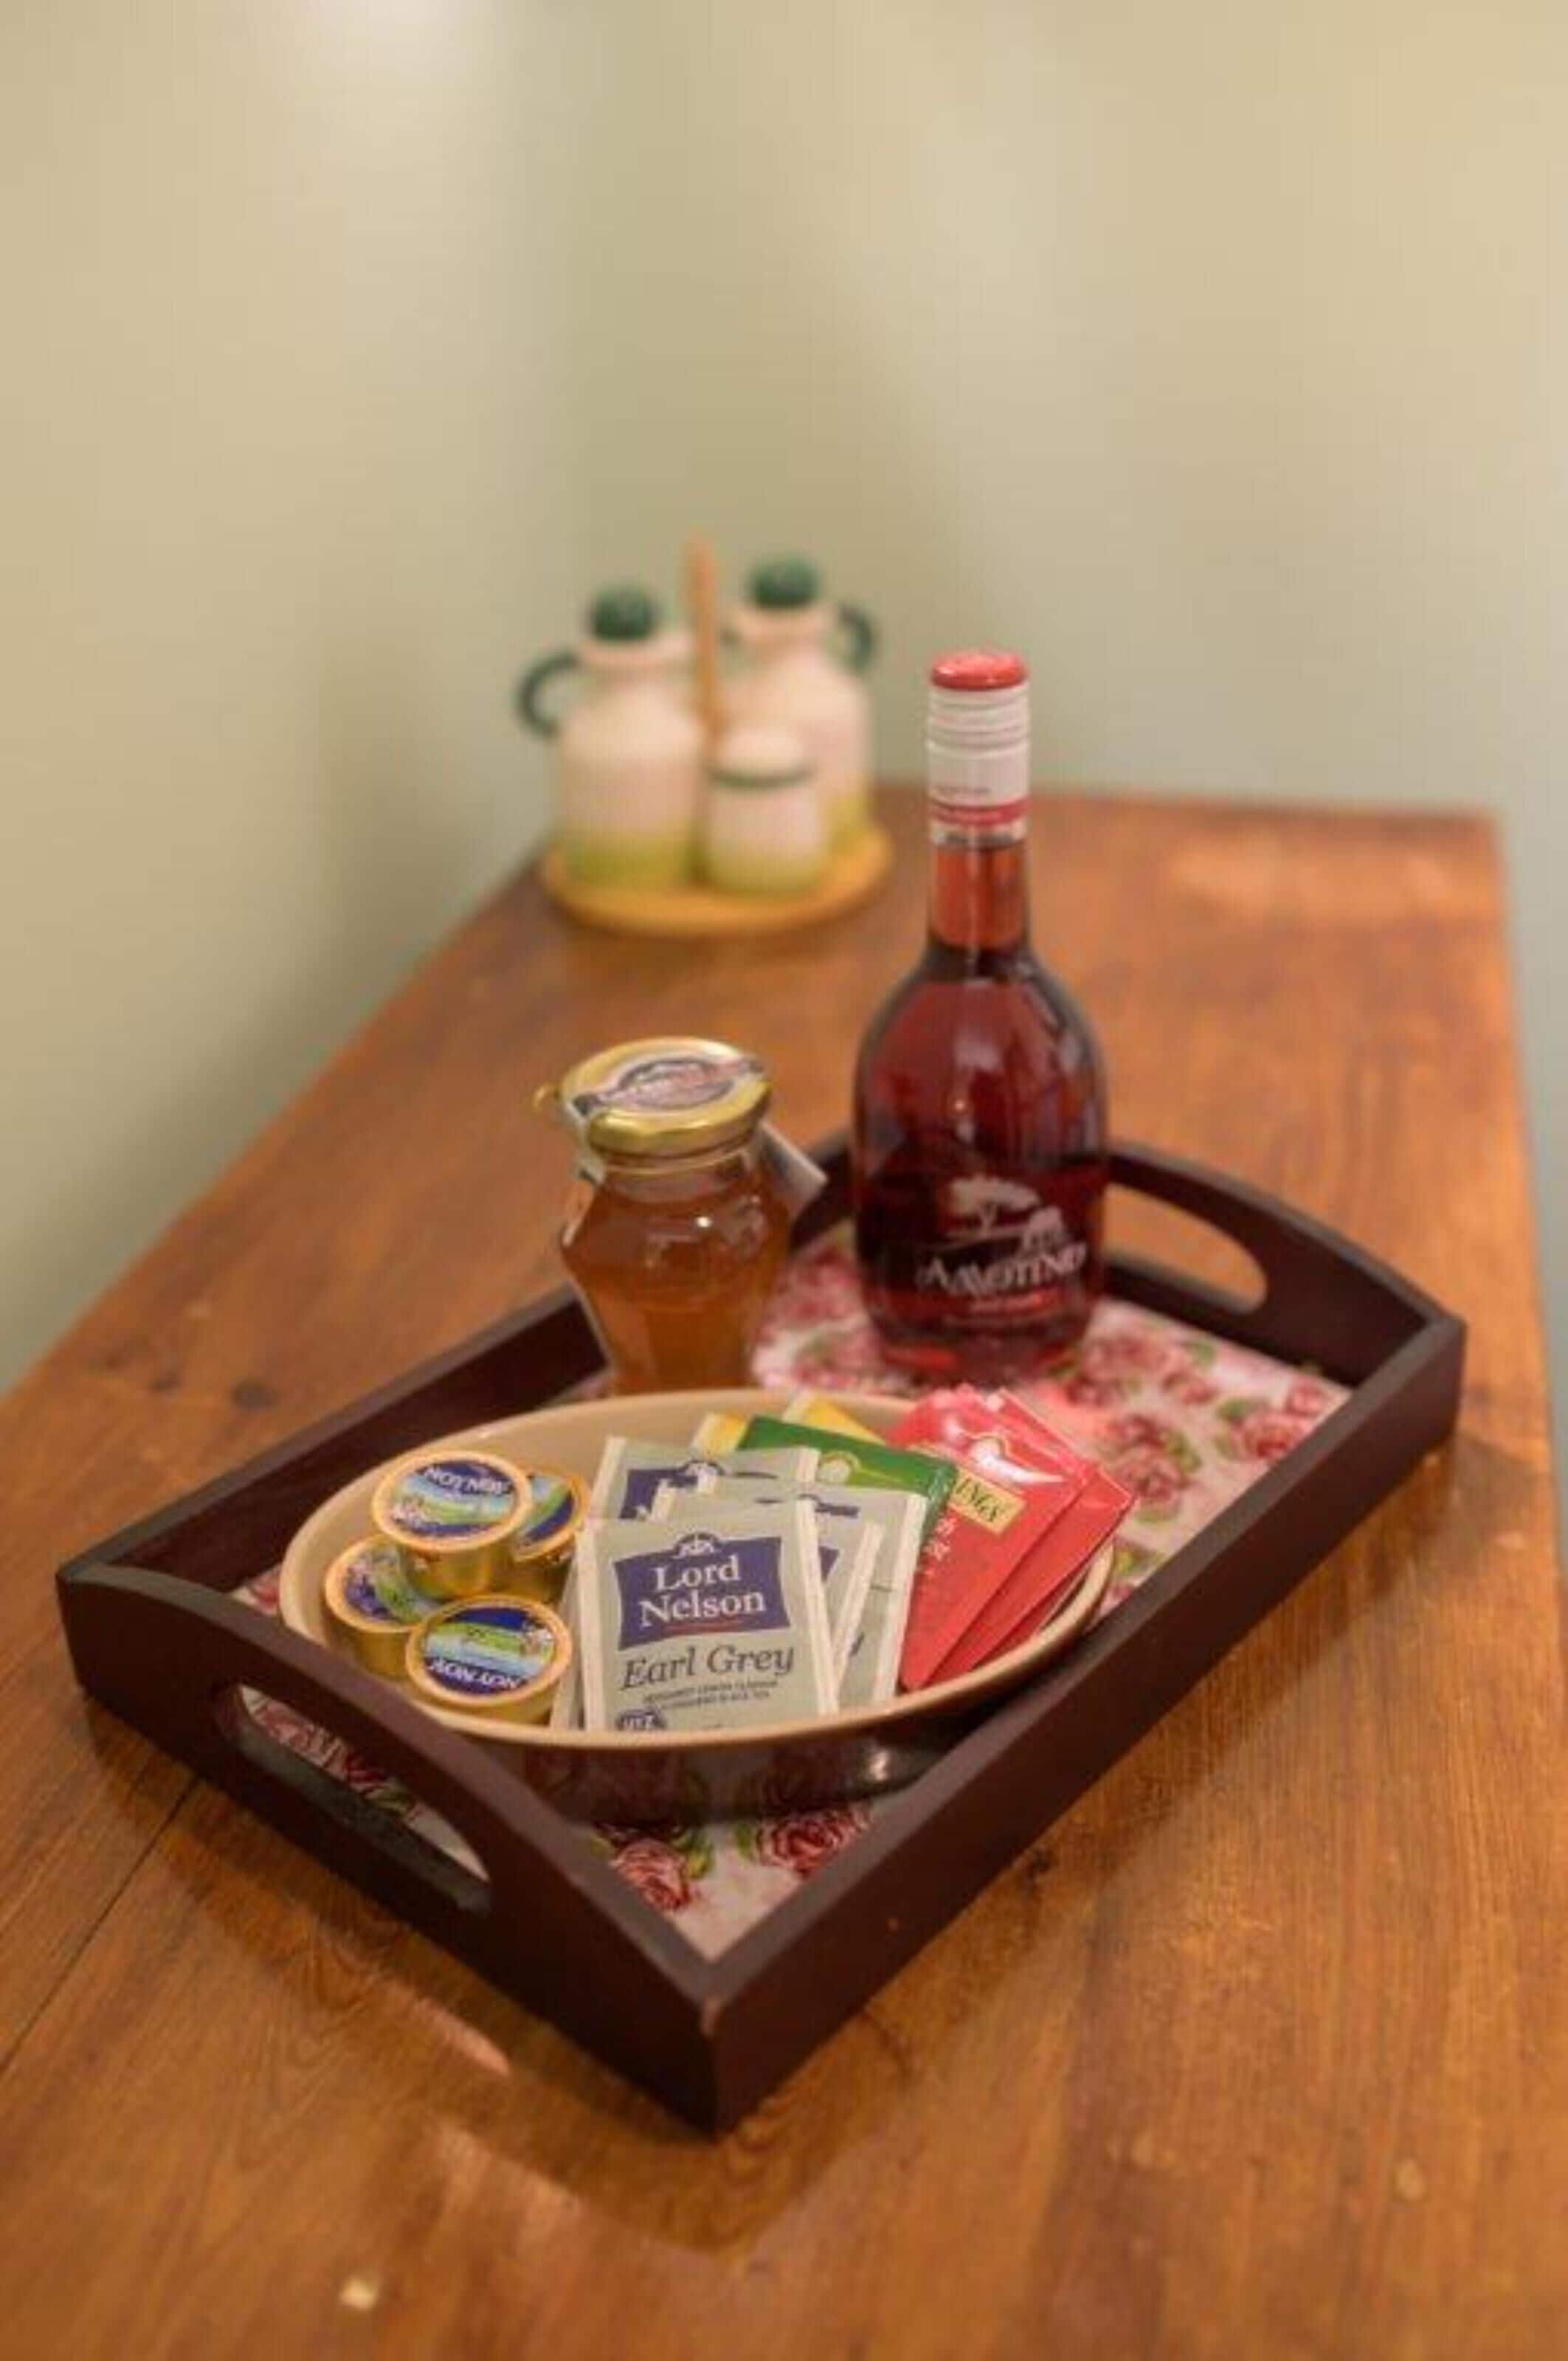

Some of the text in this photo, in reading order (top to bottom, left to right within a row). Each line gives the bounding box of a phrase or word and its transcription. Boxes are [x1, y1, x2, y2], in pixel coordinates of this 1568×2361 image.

[956, 1476, 1001, 1524] INGS
[653, 1555, 741, 1591] Lord
[638, 1589, 767, 1628] Nelson
[620, 1644, 795, 1690] Earl Grey
